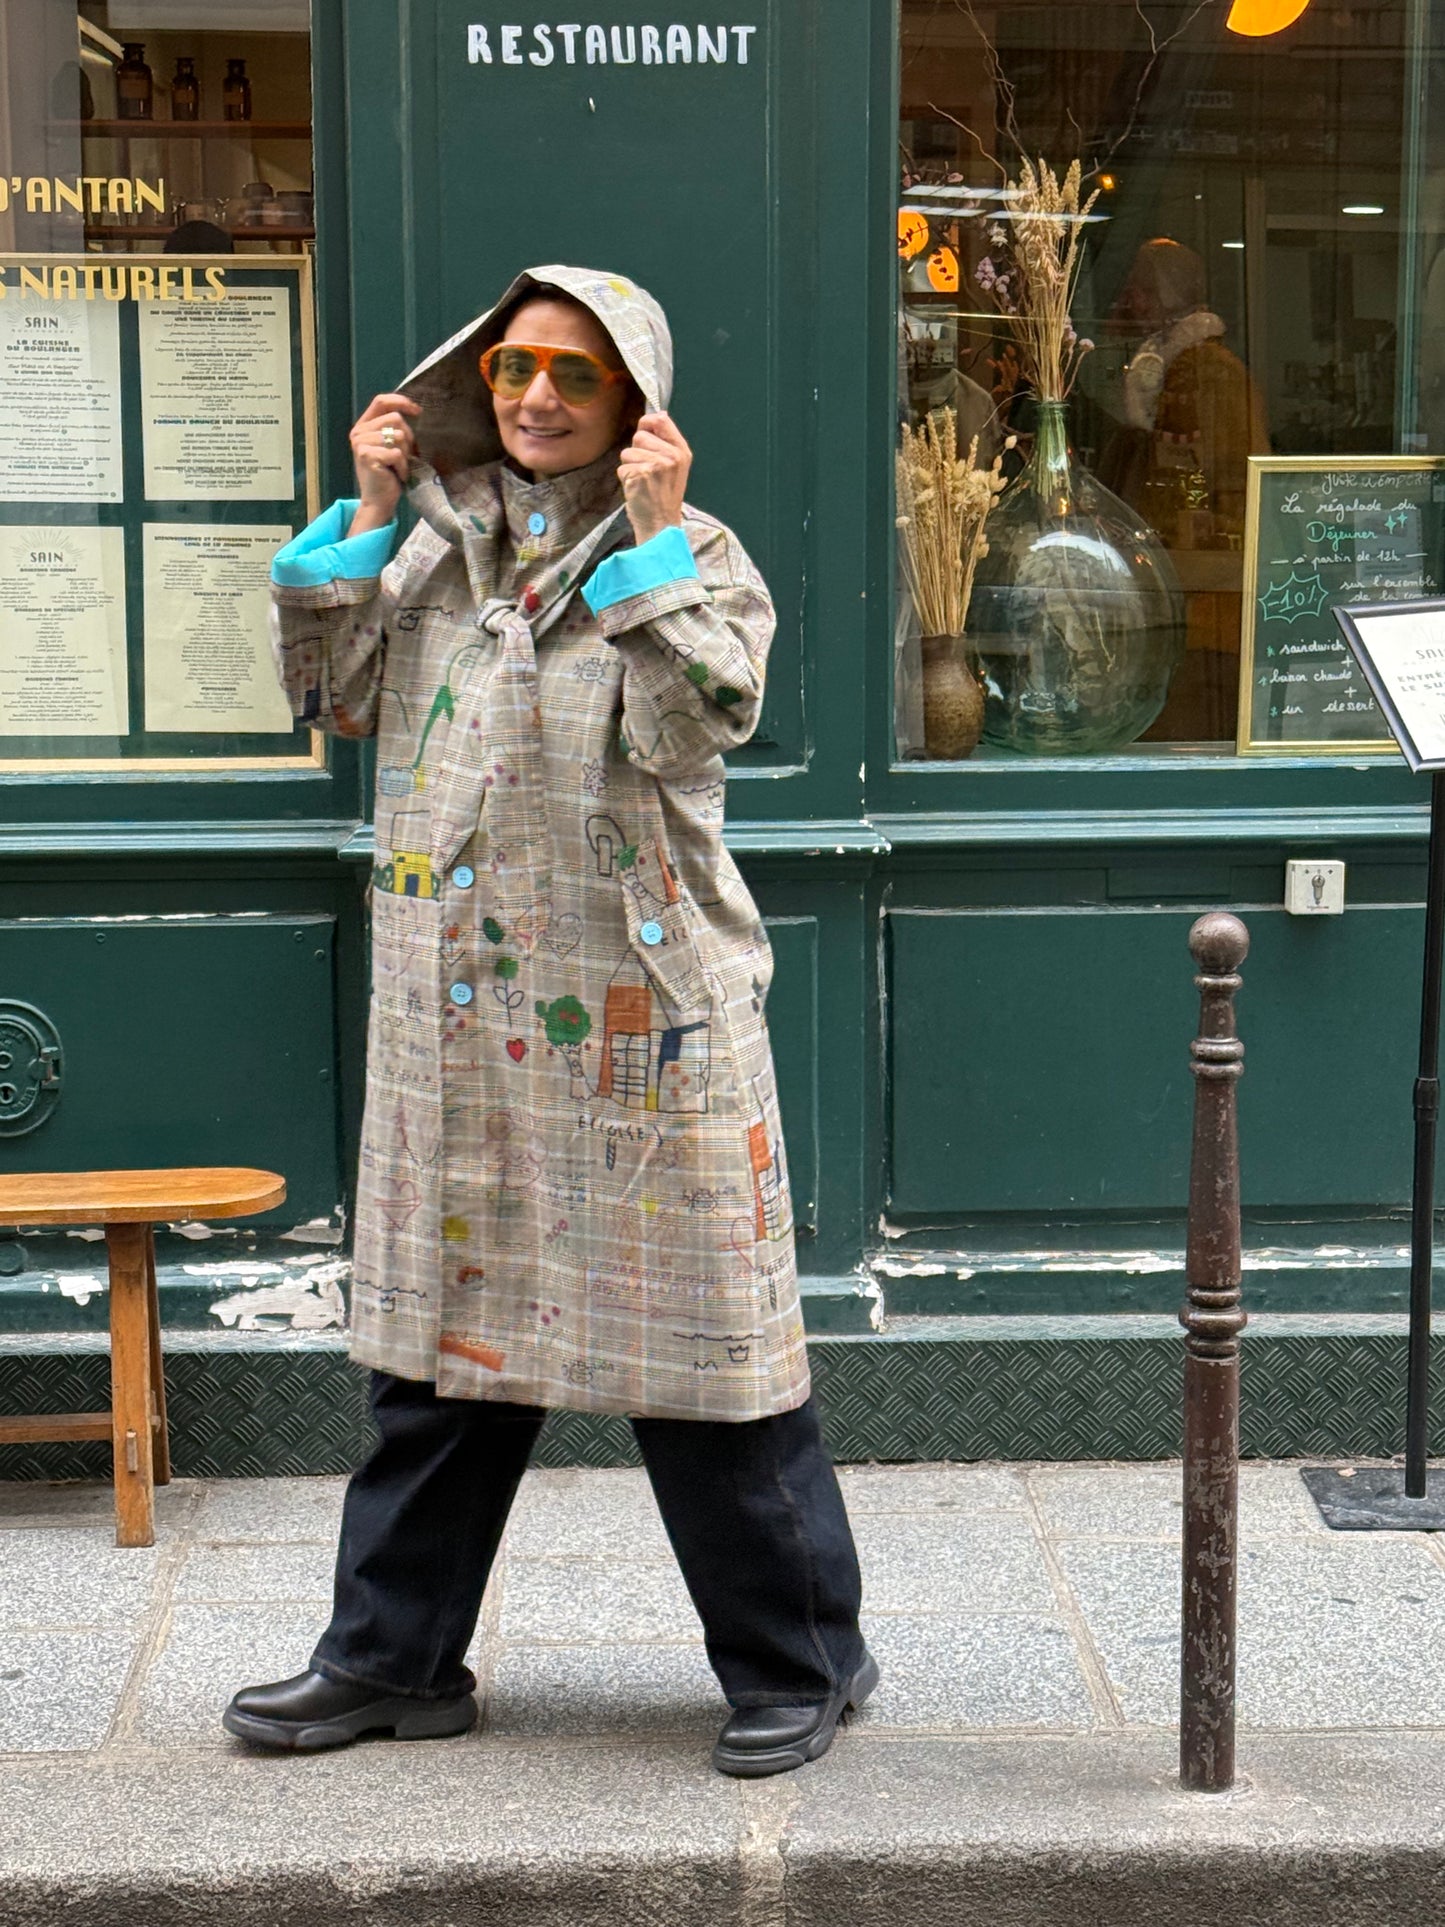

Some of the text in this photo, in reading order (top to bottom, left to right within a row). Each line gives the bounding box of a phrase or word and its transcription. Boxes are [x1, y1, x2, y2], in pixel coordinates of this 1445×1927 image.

[467, 24, 757, 66] RESTAURANT
[20, 265, 226, 301] NATURELS
[25, 317, 59, 328] SAIN
[1281, 493, 1417, 522] La régalade du
[1306, 521, 1378, 552] Déjeuner
[30, 552, 63, 563] SAIN
[1311, 554, 1352, 571] partir
[1357, 551, 1370, 562] de
[1377, 550, 1400, 562] 12h
[1340, 580, 1366, 590] sur
[1267, 585, 1317, 613] -10%
[1349, 590, 1371, 602] de
[1380, 590, 1399, 601] la
[1282, 698, 1374, 715] un dessert
